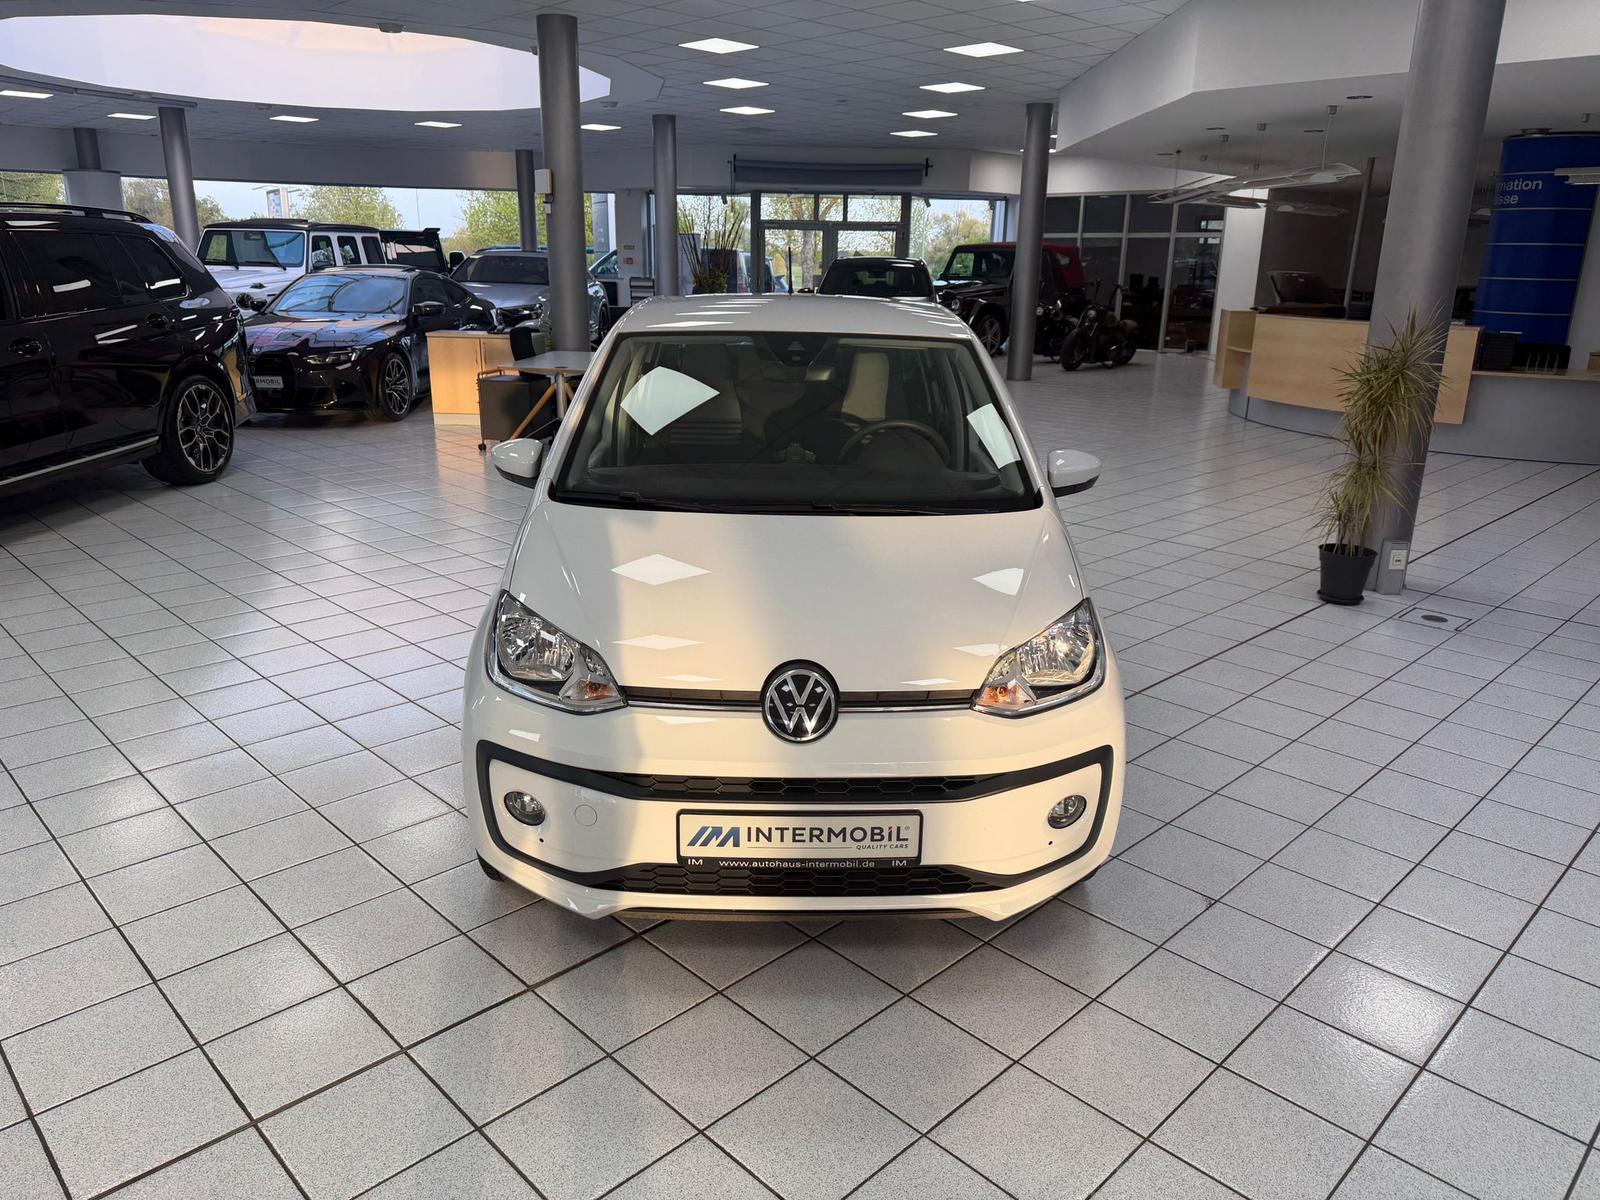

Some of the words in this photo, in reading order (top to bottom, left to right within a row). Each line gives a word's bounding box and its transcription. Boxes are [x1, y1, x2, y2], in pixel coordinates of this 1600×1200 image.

[687, 858, 703, 866] IM
[718, 859, 875, 868] www.autohaus-intermobil.de
[891, 859, 907, 867] IM
